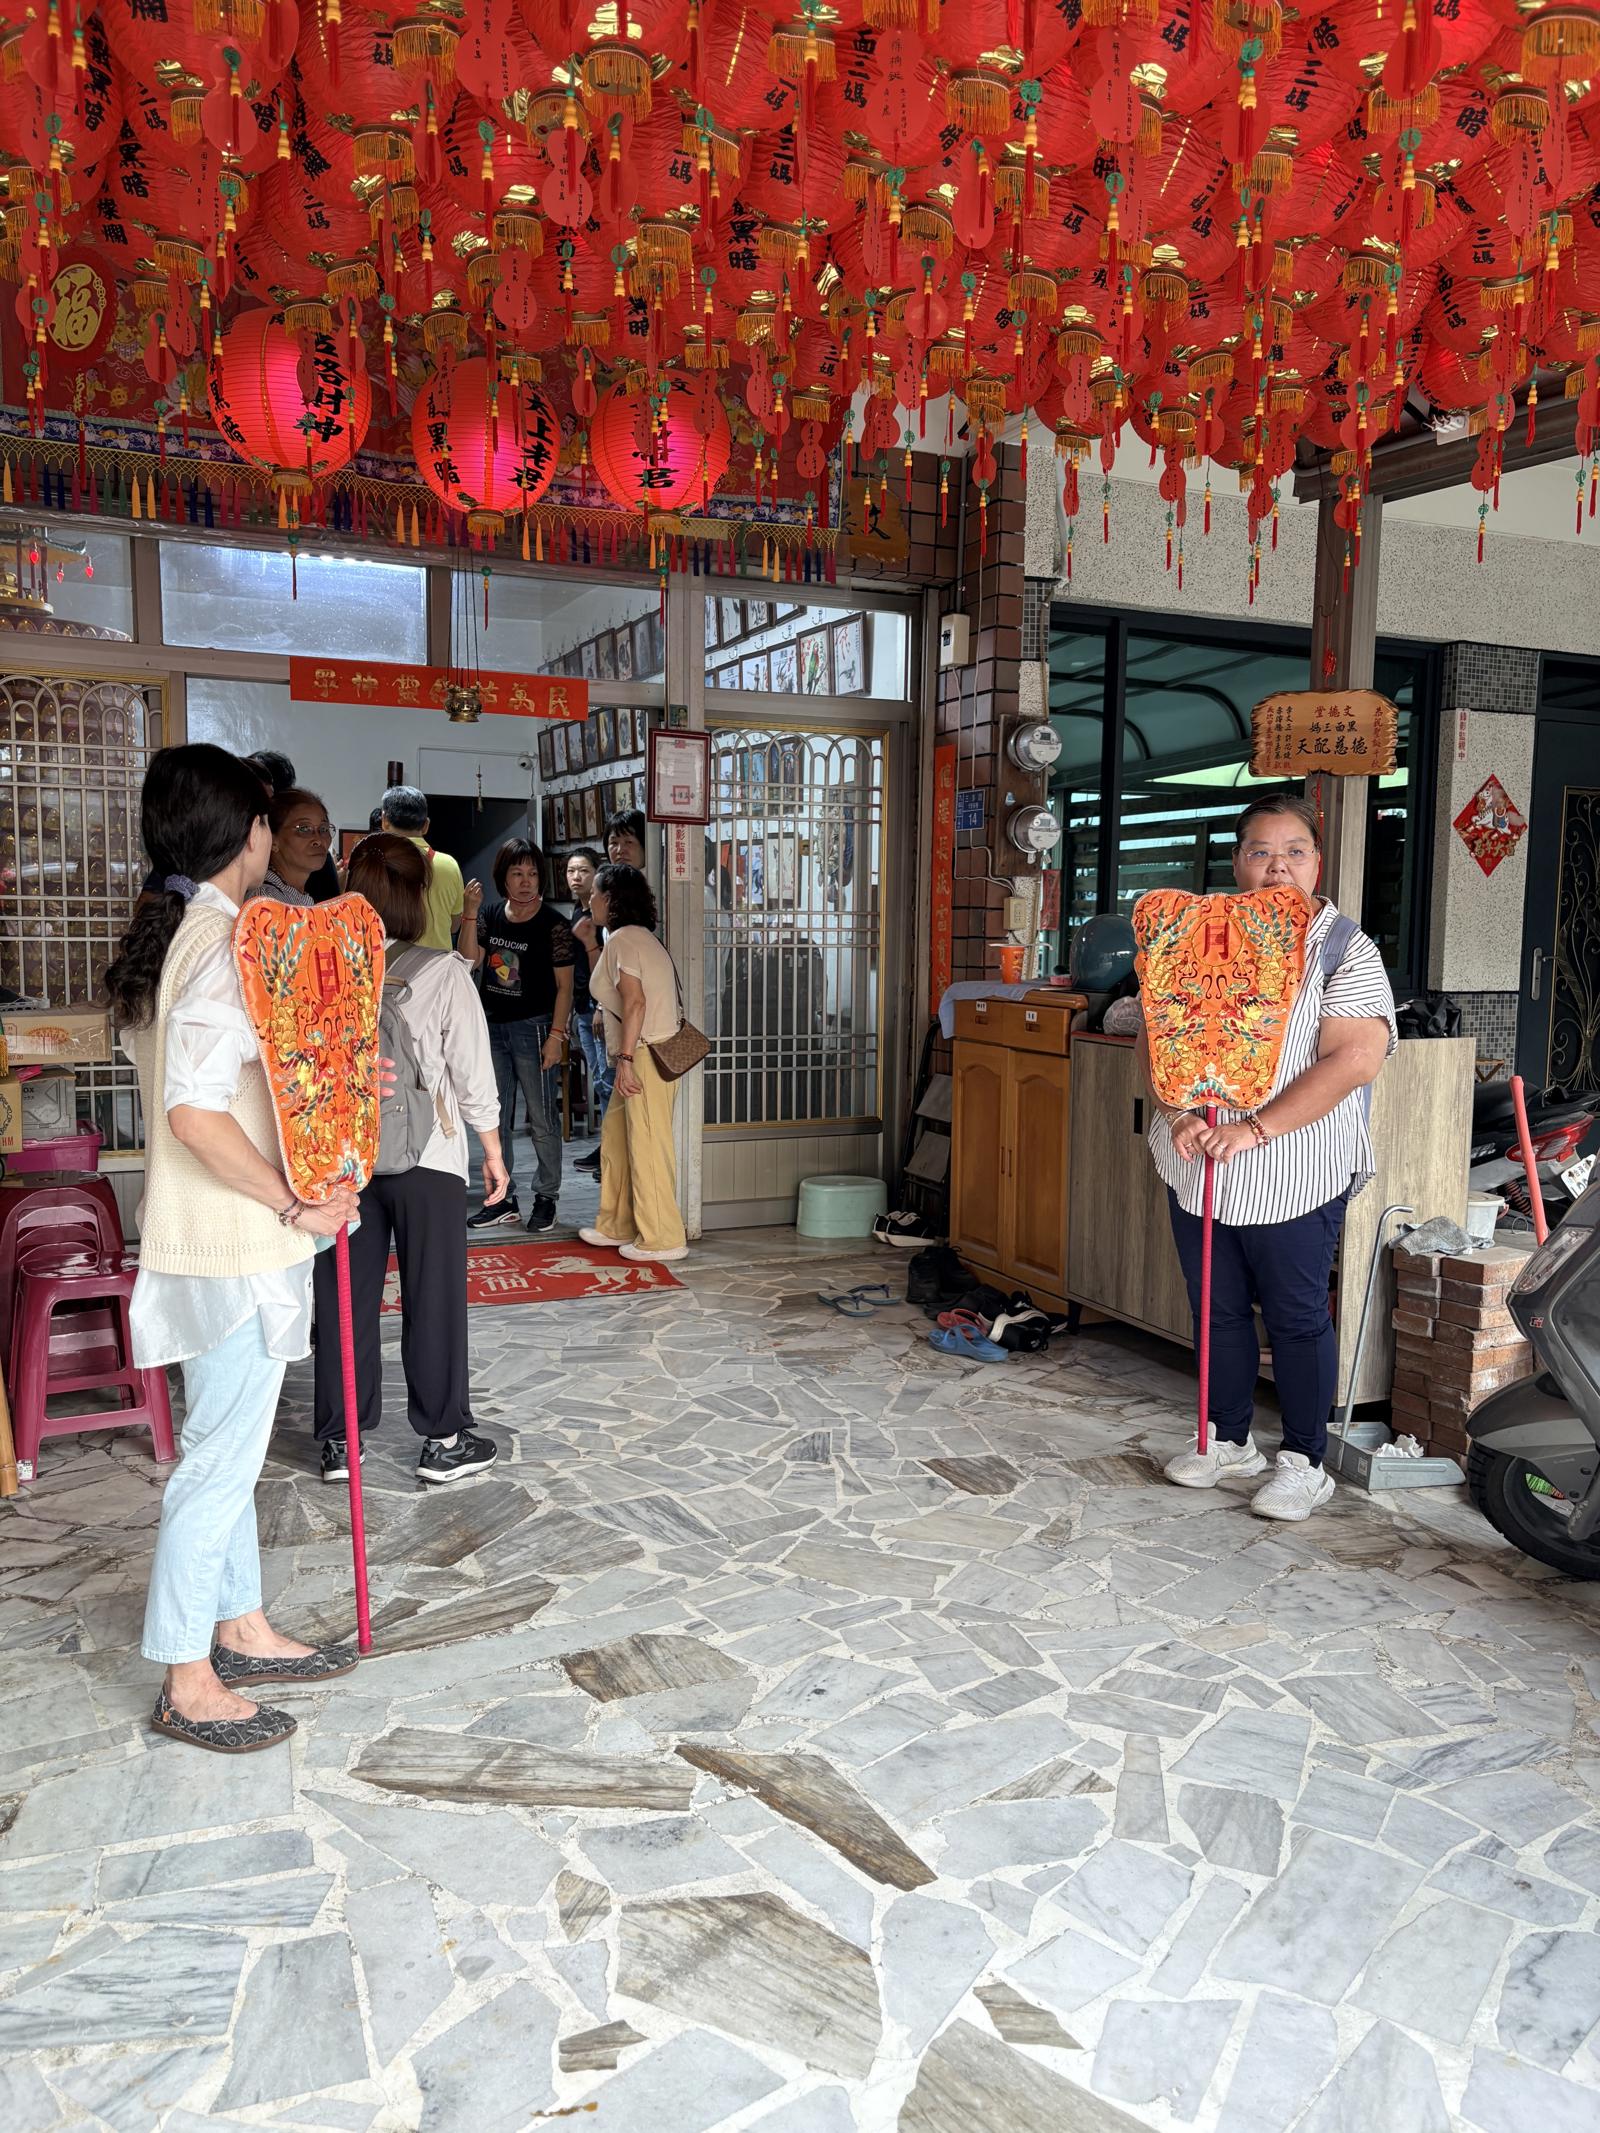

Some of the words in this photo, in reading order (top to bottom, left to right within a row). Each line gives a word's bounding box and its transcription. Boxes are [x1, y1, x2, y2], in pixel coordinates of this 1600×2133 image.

[508, 393, 556, 491] 太上老君
[1308, 720, 1358, 735] 黑面三媽
